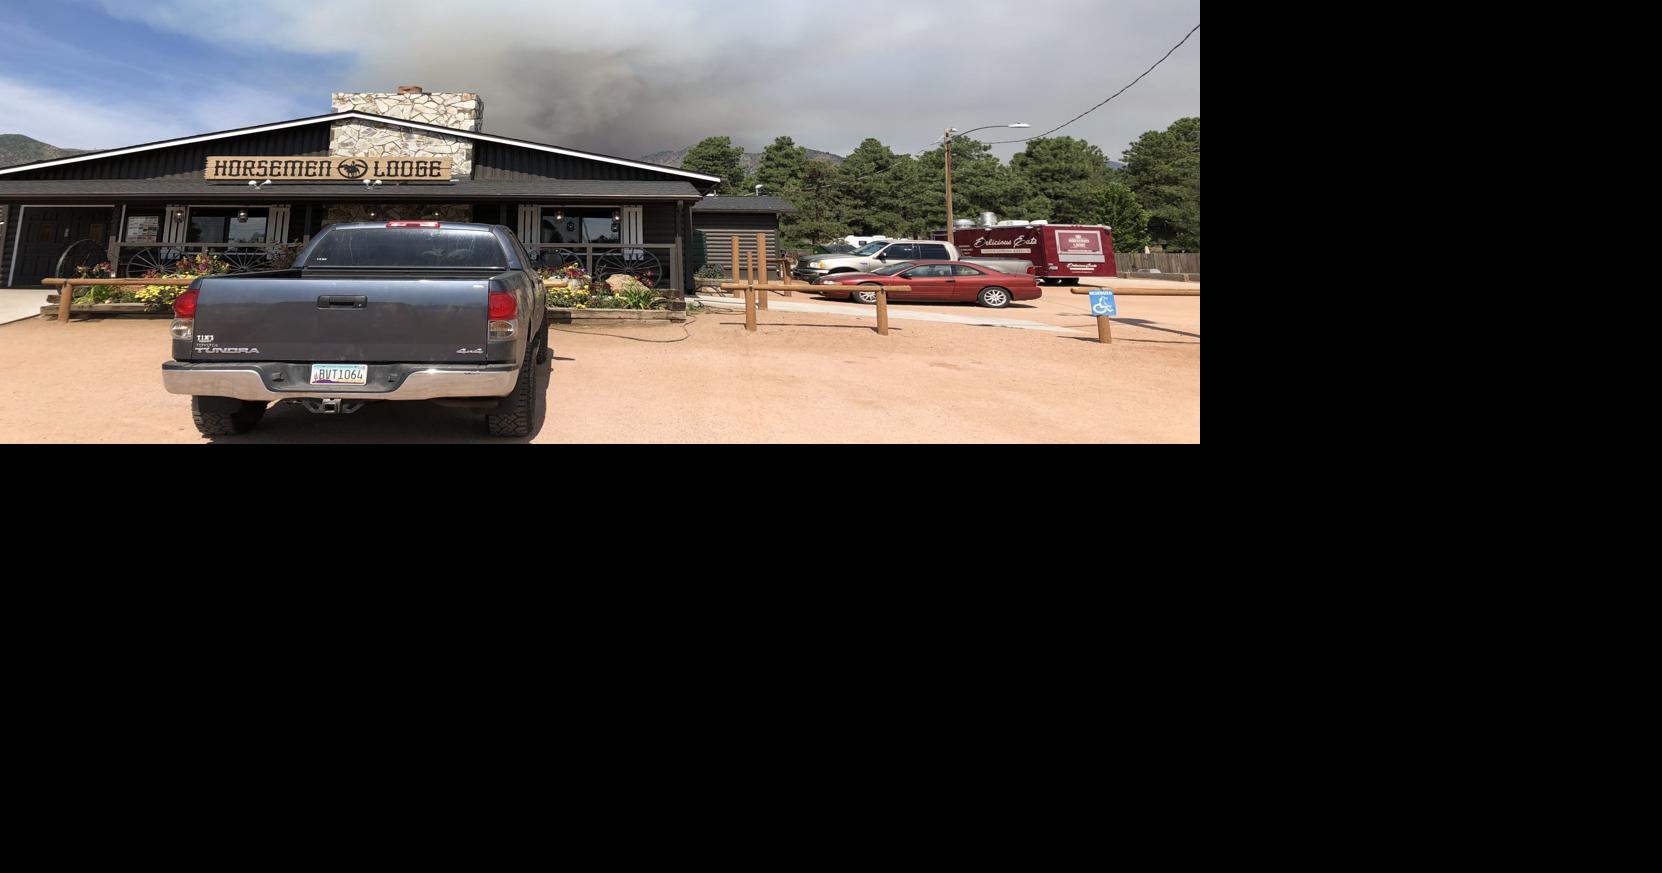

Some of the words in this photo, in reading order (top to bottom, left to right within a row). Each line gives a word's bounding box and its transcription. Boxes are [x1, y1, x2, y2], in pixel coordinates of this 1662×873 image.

[213, 160, 332, 177] HORSEMEN
[373, 160, 442, 177] LODGE
[974, 237, 1012, 248] Delicious
[1013, 235, 1037, 248] Eats
[319, 369, 363, 380] BVT1064
